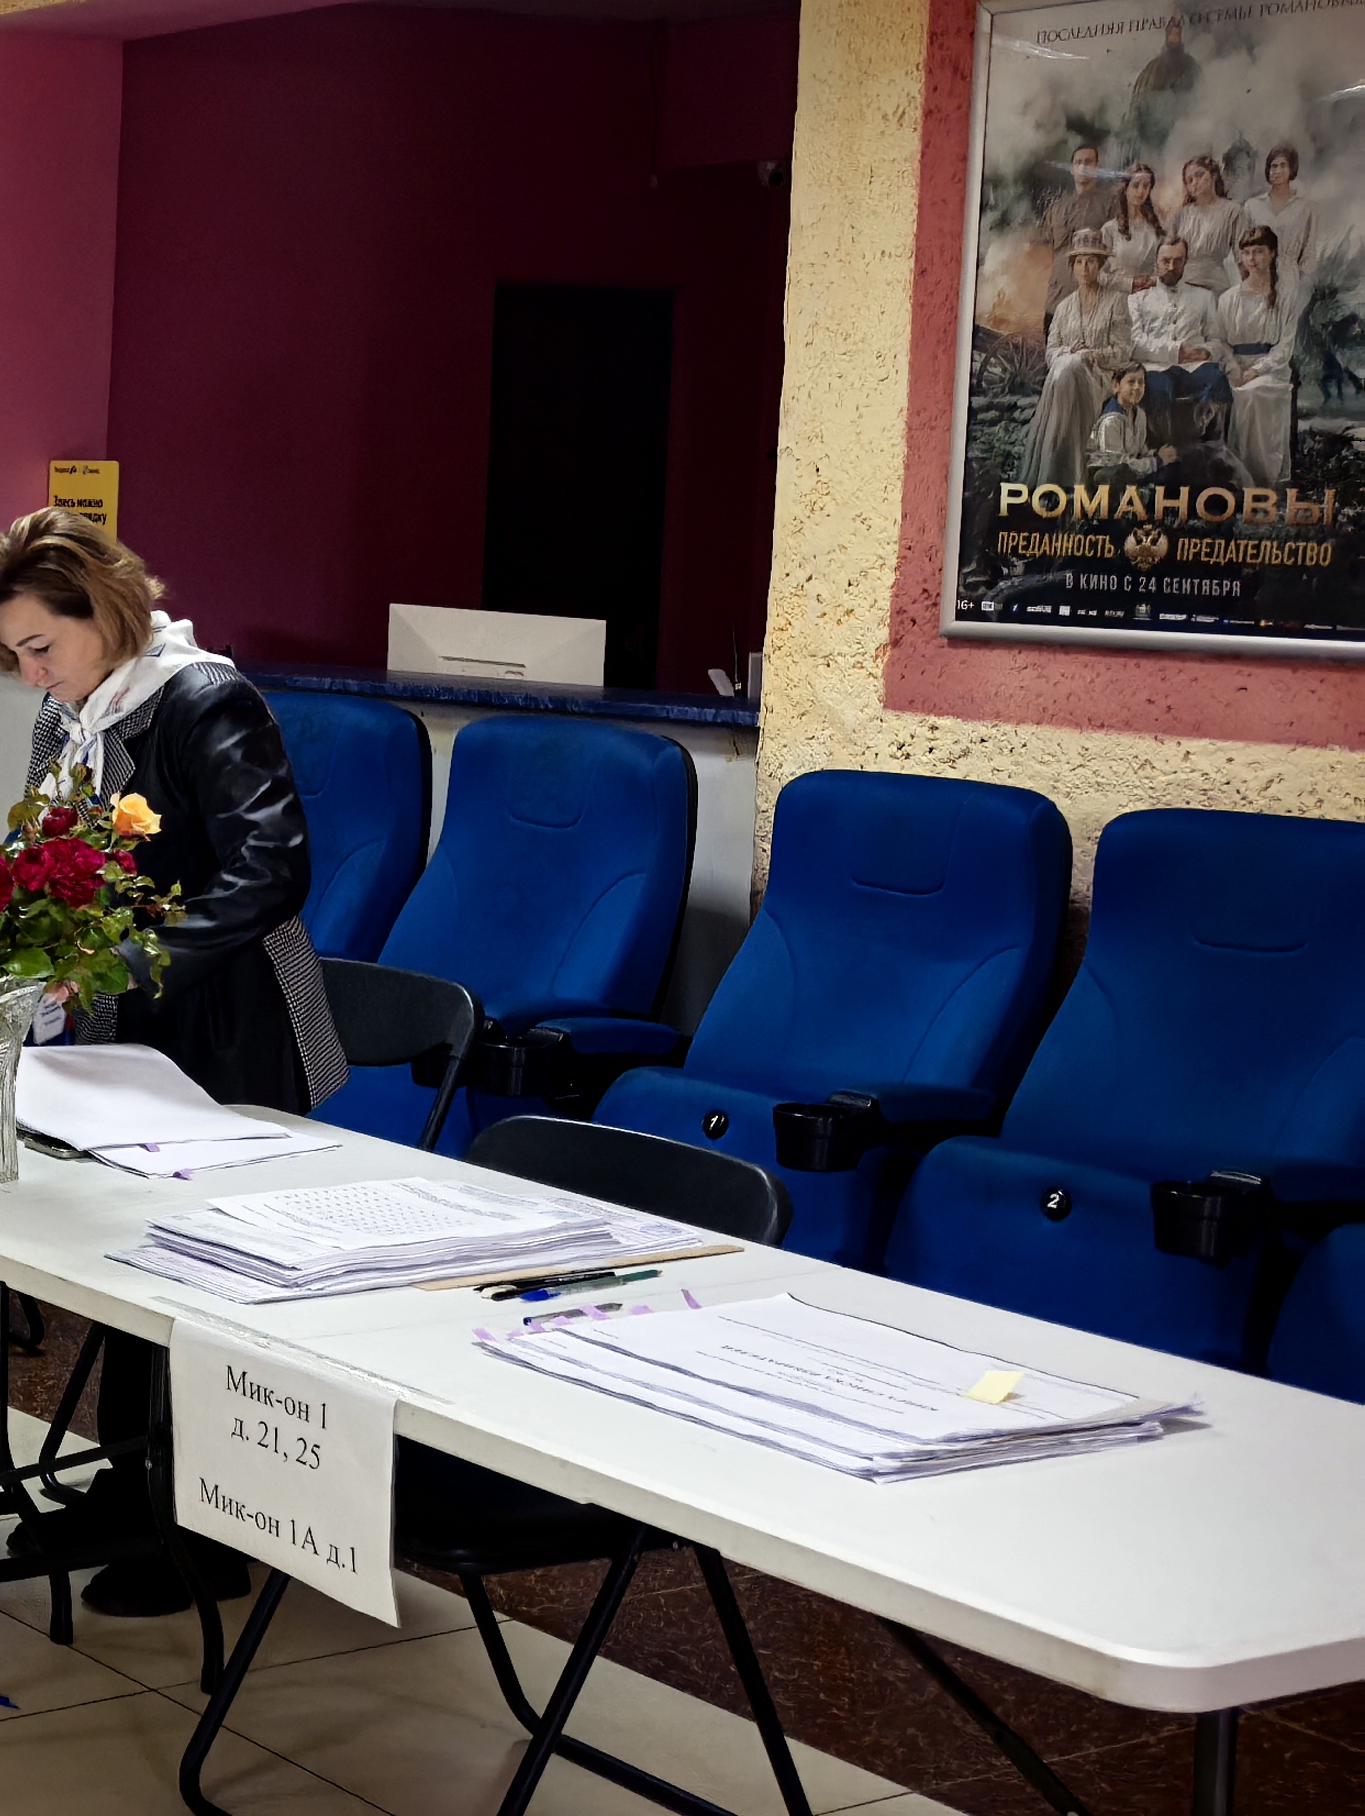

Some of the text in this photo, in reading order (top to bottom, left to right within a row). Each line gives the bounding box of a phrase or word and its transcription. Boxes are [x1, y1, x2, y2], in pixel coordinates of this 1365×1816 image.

[997, 482, 1337, 526] РОМАНОВЫ
[997, 530, 1333, 567] ПРЕДАННОСТЬ ПРЕДАТЕЛЬСТВО
[1065, 574, 1242, 597] В КИНО С 24 СЕНТЯБРЯ
[957, 599, 975, 611] 16+
[710, 1115, 719, 1130] 1
[1047, 1193, 1060, 1209] 2
[226, 1365, 311, 1423] Мик-он
[231, 1417, 321, 1470] д. 21, 25
[199, 1476, 281, 1538] Мик-он
[290, 1519, 320, 1556] 1А
